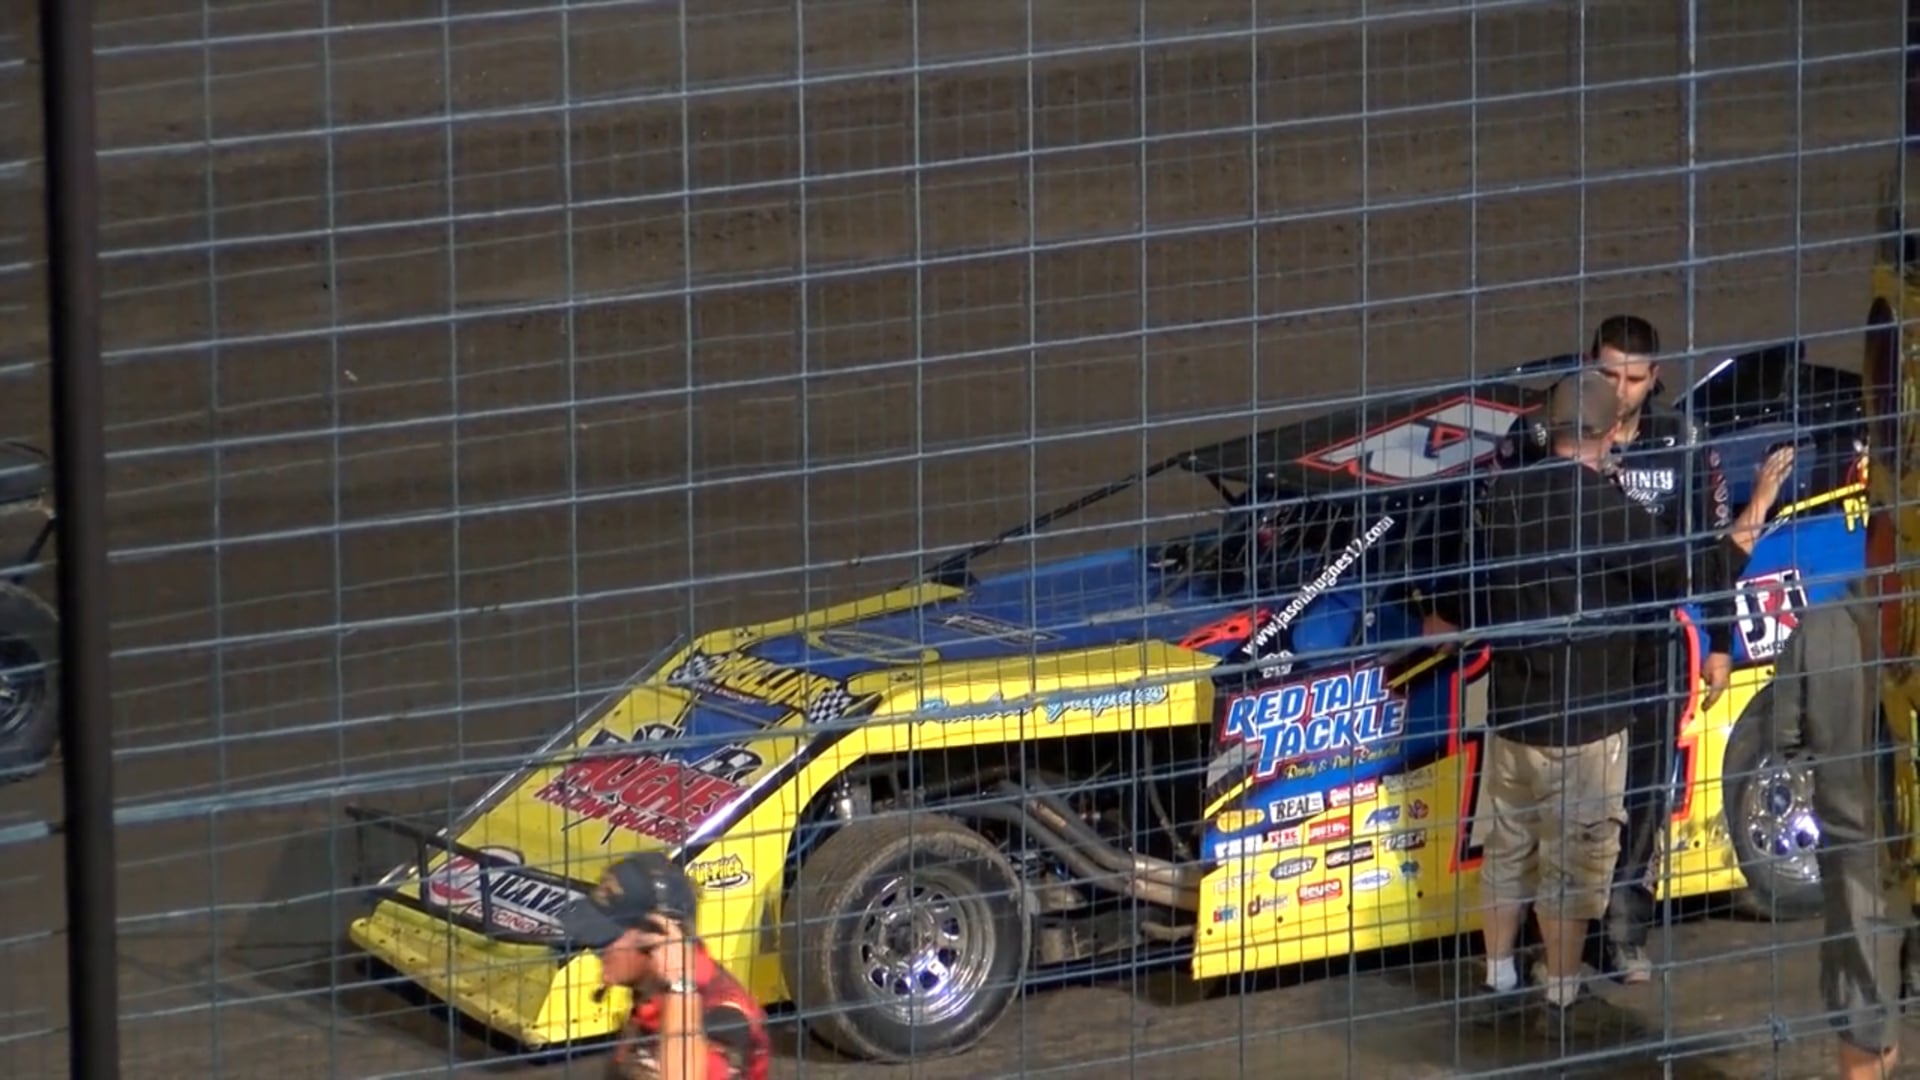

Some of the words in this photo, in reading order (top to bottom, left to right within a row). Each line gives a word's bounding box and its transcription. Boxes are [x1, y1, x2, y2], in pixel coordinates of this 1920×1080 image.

[1224, 684, 1307, 741] RED
[1310, 667, 1389, 713] TAIL
[1257, 699, 1408, 780] TACKLE
